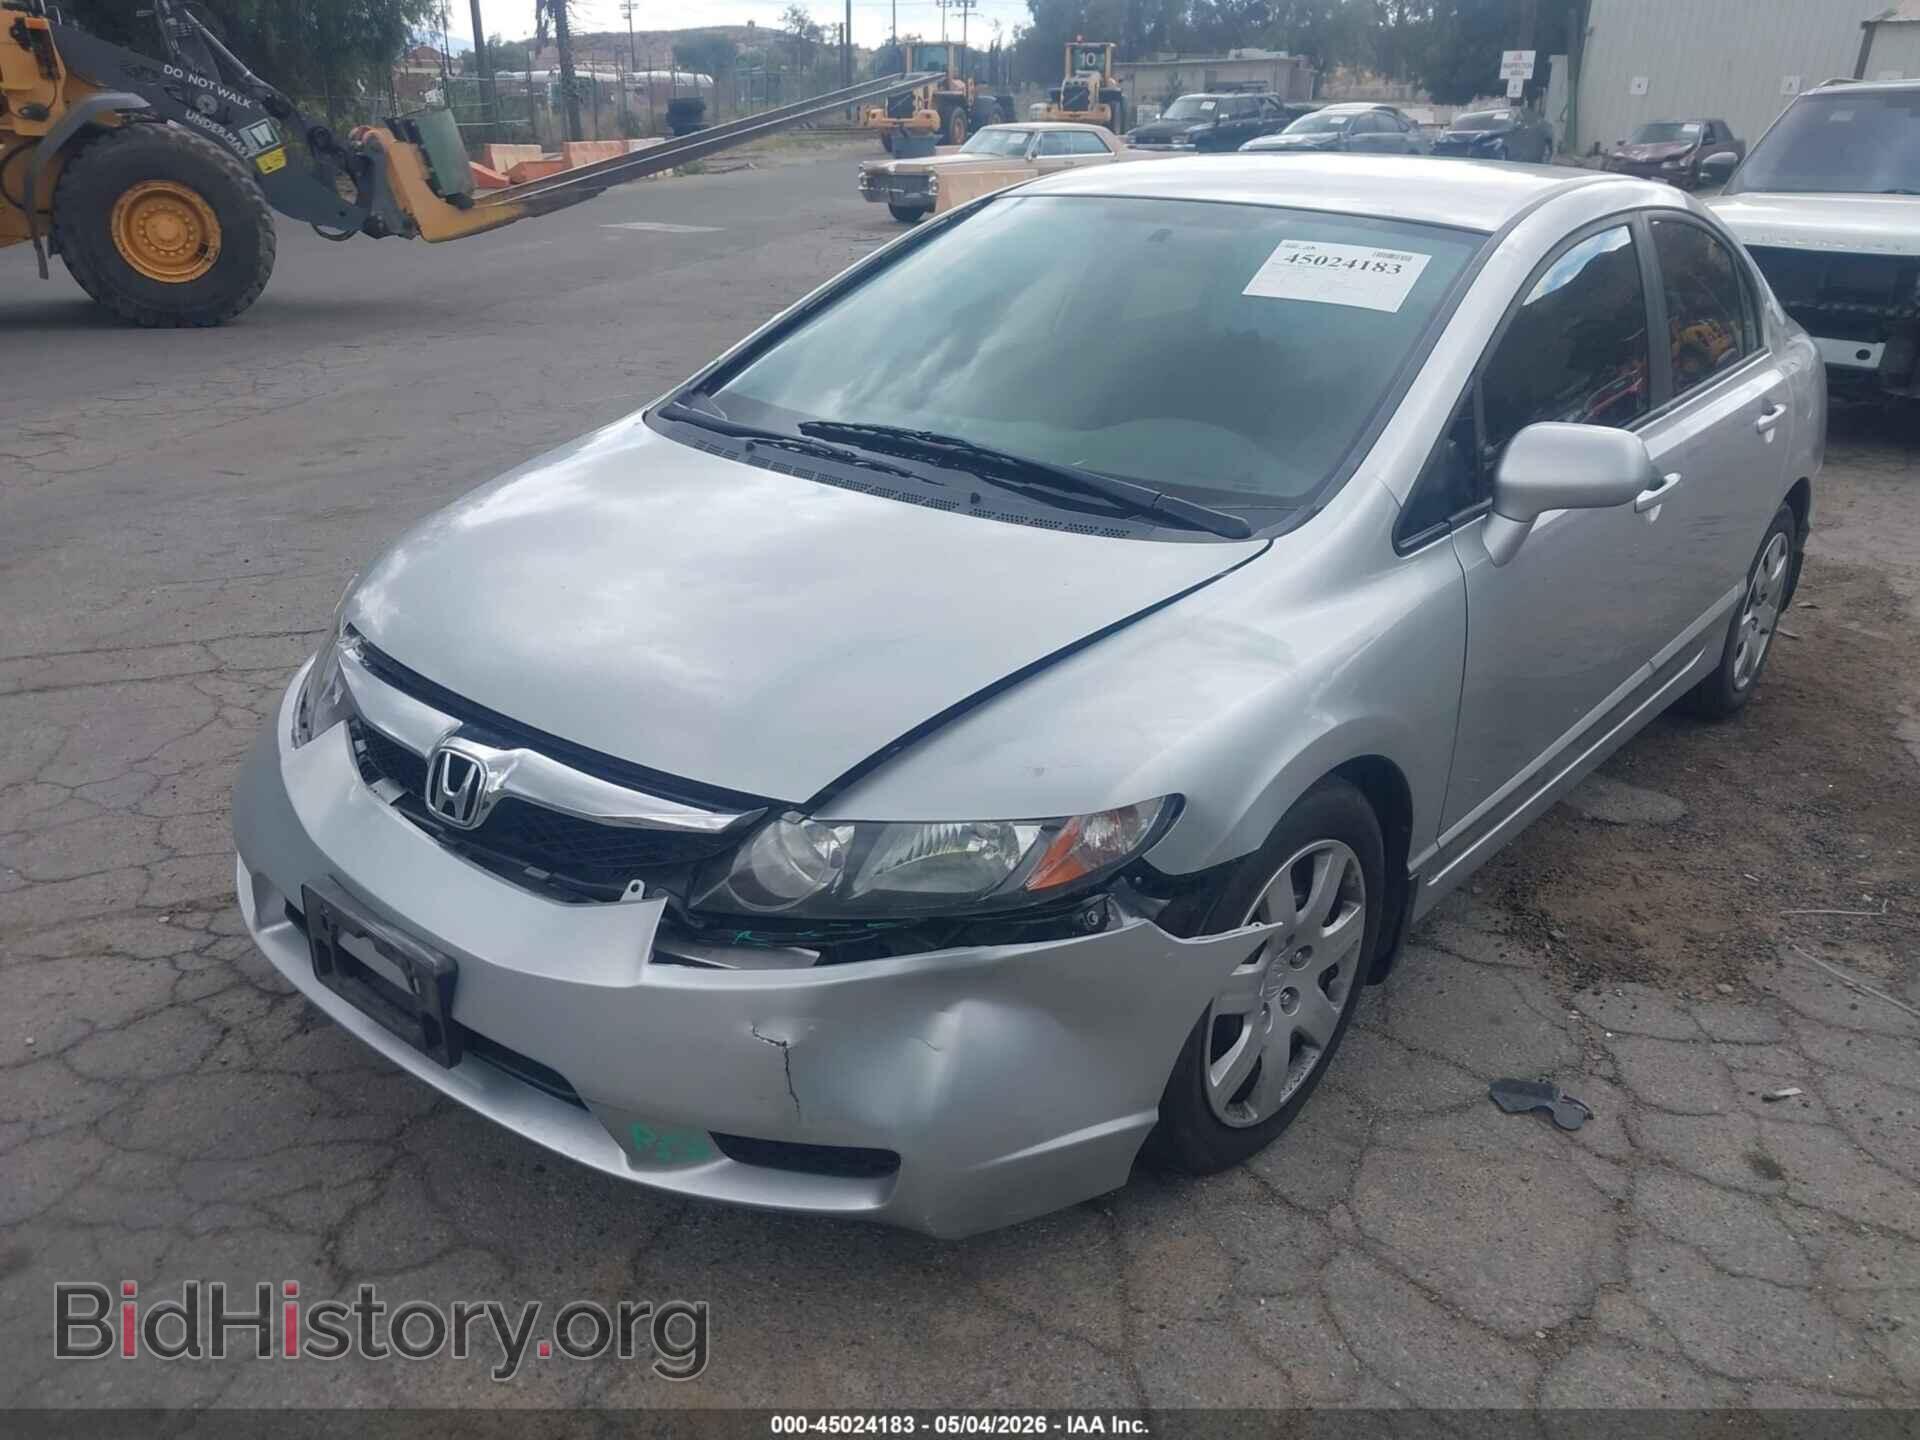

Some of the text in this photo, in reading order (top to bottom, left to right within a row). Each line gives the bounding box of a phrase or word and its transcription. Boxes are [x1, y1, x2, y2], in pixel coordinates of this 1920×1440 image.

[1080, 52, 1096, 66] 10
[163, 64, 252, 109] DO NOT WALK
[1283, 253, 1403, 275] 45024183
